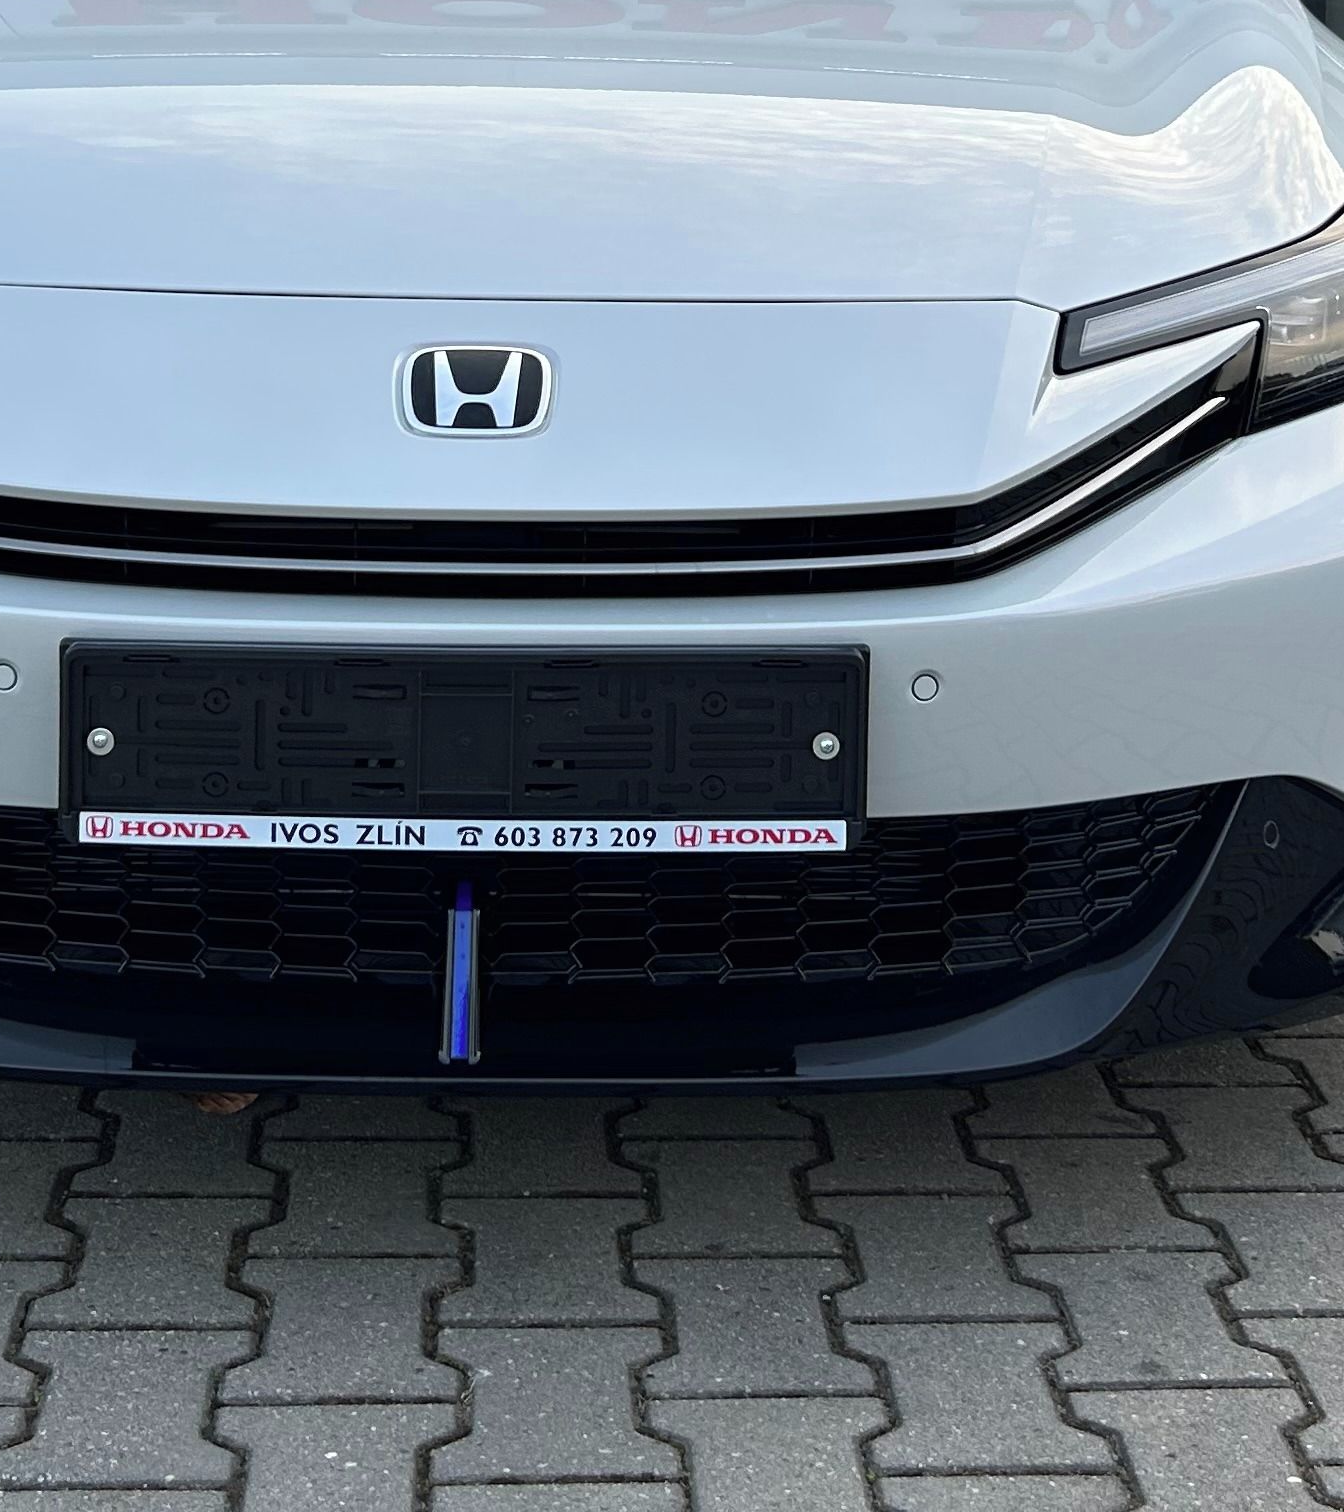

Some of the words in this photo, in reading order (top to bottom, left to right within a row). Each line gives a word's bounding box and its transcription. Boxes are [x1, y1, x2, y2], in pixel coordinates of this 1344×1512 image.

[119, 820, 251, 840] HONDA
[270, 821, 340, 845] IVOS
[356, 819, 426, 846] ZLÍN
[494, 826, 542, 847] 603
[552, 826, 599, 848] 873
[610, 827, 657, 848] 209
[708, 828, 839, 845] HONDA
